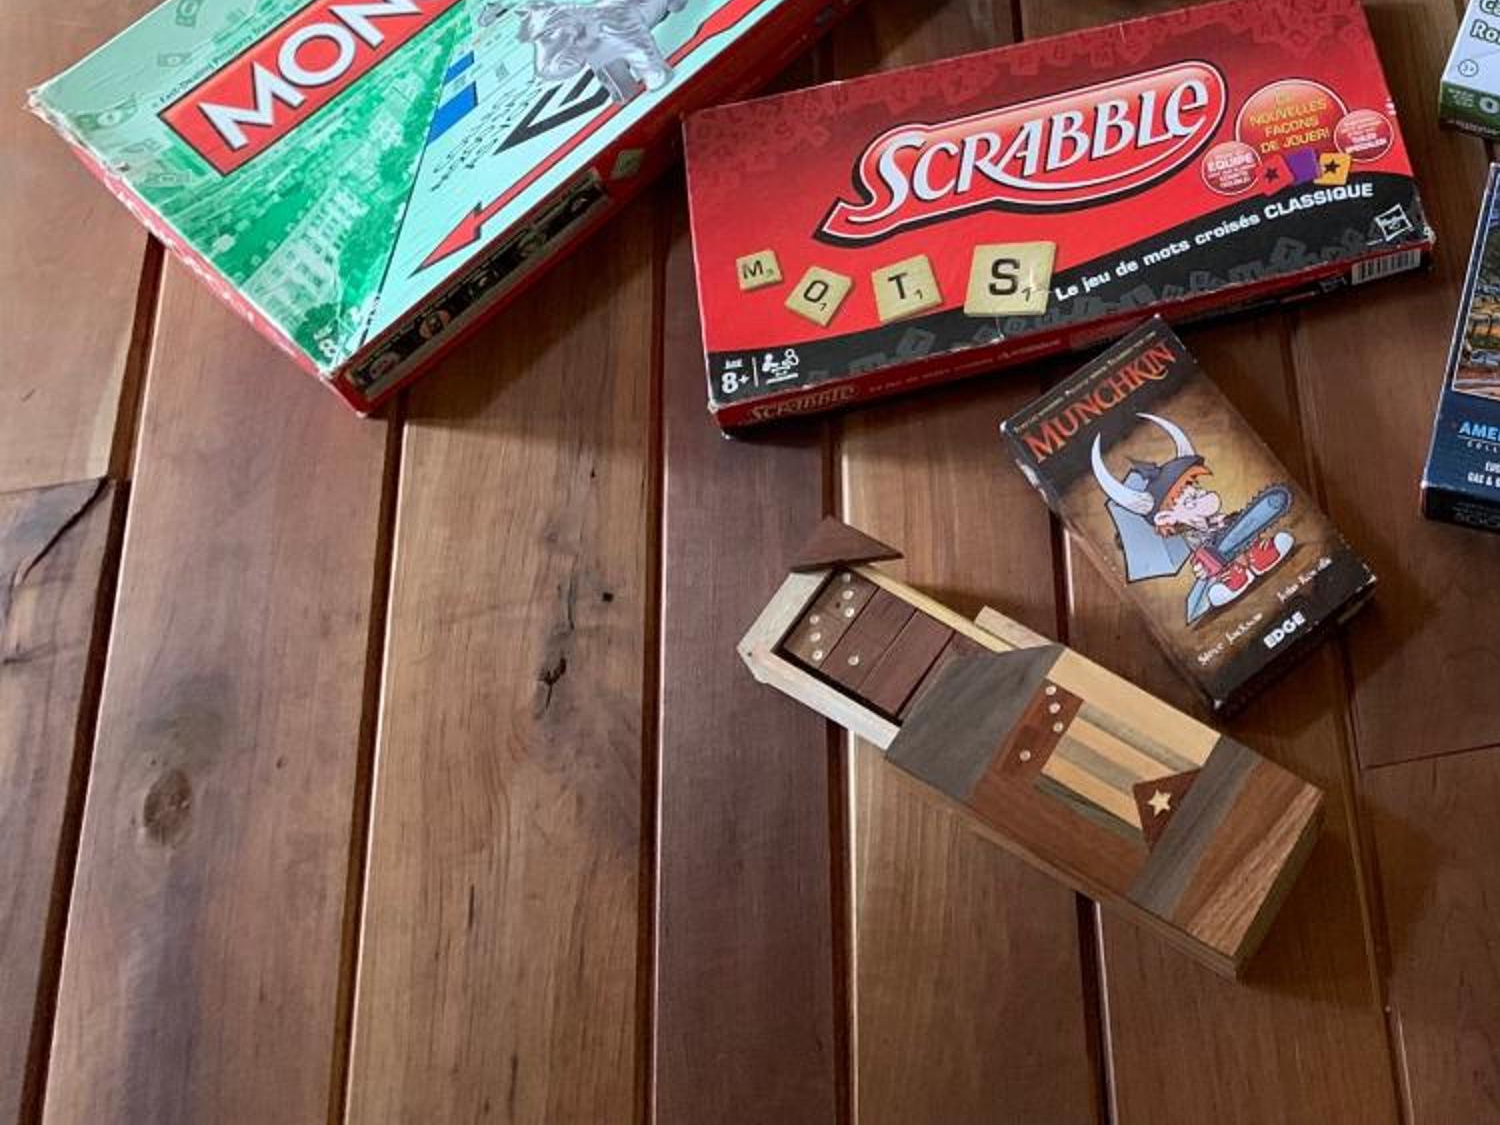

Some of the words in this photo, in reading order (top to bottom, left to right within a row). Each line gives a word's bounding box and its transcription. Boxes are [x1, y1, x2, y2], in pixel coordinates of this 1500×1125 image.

[1260, 143, 1280, 154] DE
[1054, 284, 1079, 302] Le
[1082, 272, 1111, 294] jeu
[1115, 259, 1139, 277] de
[1143, 241, 1191, 266] mots
[1194, 214, 1261, 247] croisés
[1263, 183, 1375, 221] CLASSIQUE
[742, 260, 765, 279] M
[803, 279, 829, 304] O
[887, 272, 909, 301] T
[988, 258, 1021, 297] S
[720, 371, 751, 394] 8+
[1024, 338, 1177, 464] MUNCHKIN
[1263, 611, 1307, 649] EDGE
